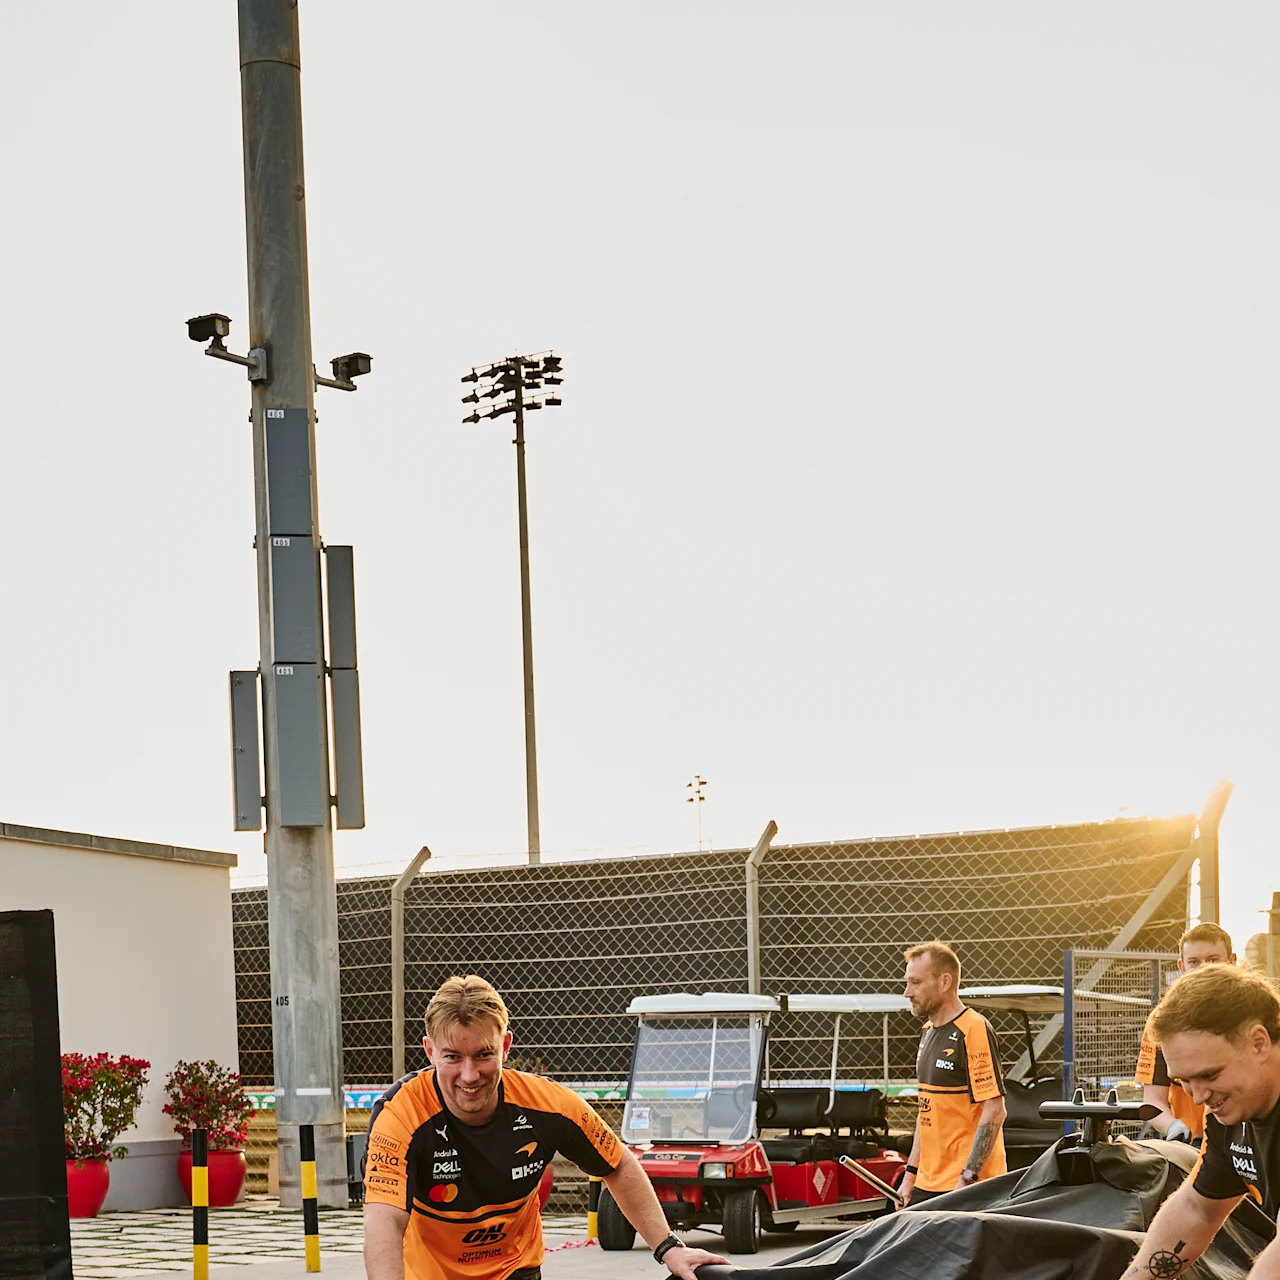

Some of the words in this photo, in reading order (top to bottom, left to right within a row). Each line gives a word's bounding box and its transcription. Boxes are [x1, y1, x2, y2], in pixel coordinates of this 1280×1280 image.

[970, 1051, 989, 1061] FxPro
[935, 1058, 955, 1071] OKX
[373, 1133, 398, 1150] Hilton
[371, 1152, 399, 1167] okta
[655, 1153, 671, 1161] Club
[672, 1153, 686, 1161] Car
[433, 1160, 461, 1174] DELL
[511, 1160, 544, 1180] OKX
[1232, 1155, 1257, 1173] DELL
[368, 1176, 399, 1187] PIRELLI
[462, 1222, 505, 1243] ON
[458, 1252, 502, 1263] NUTRITION
[462, 1249, 501, 1258] OPTIMUM
